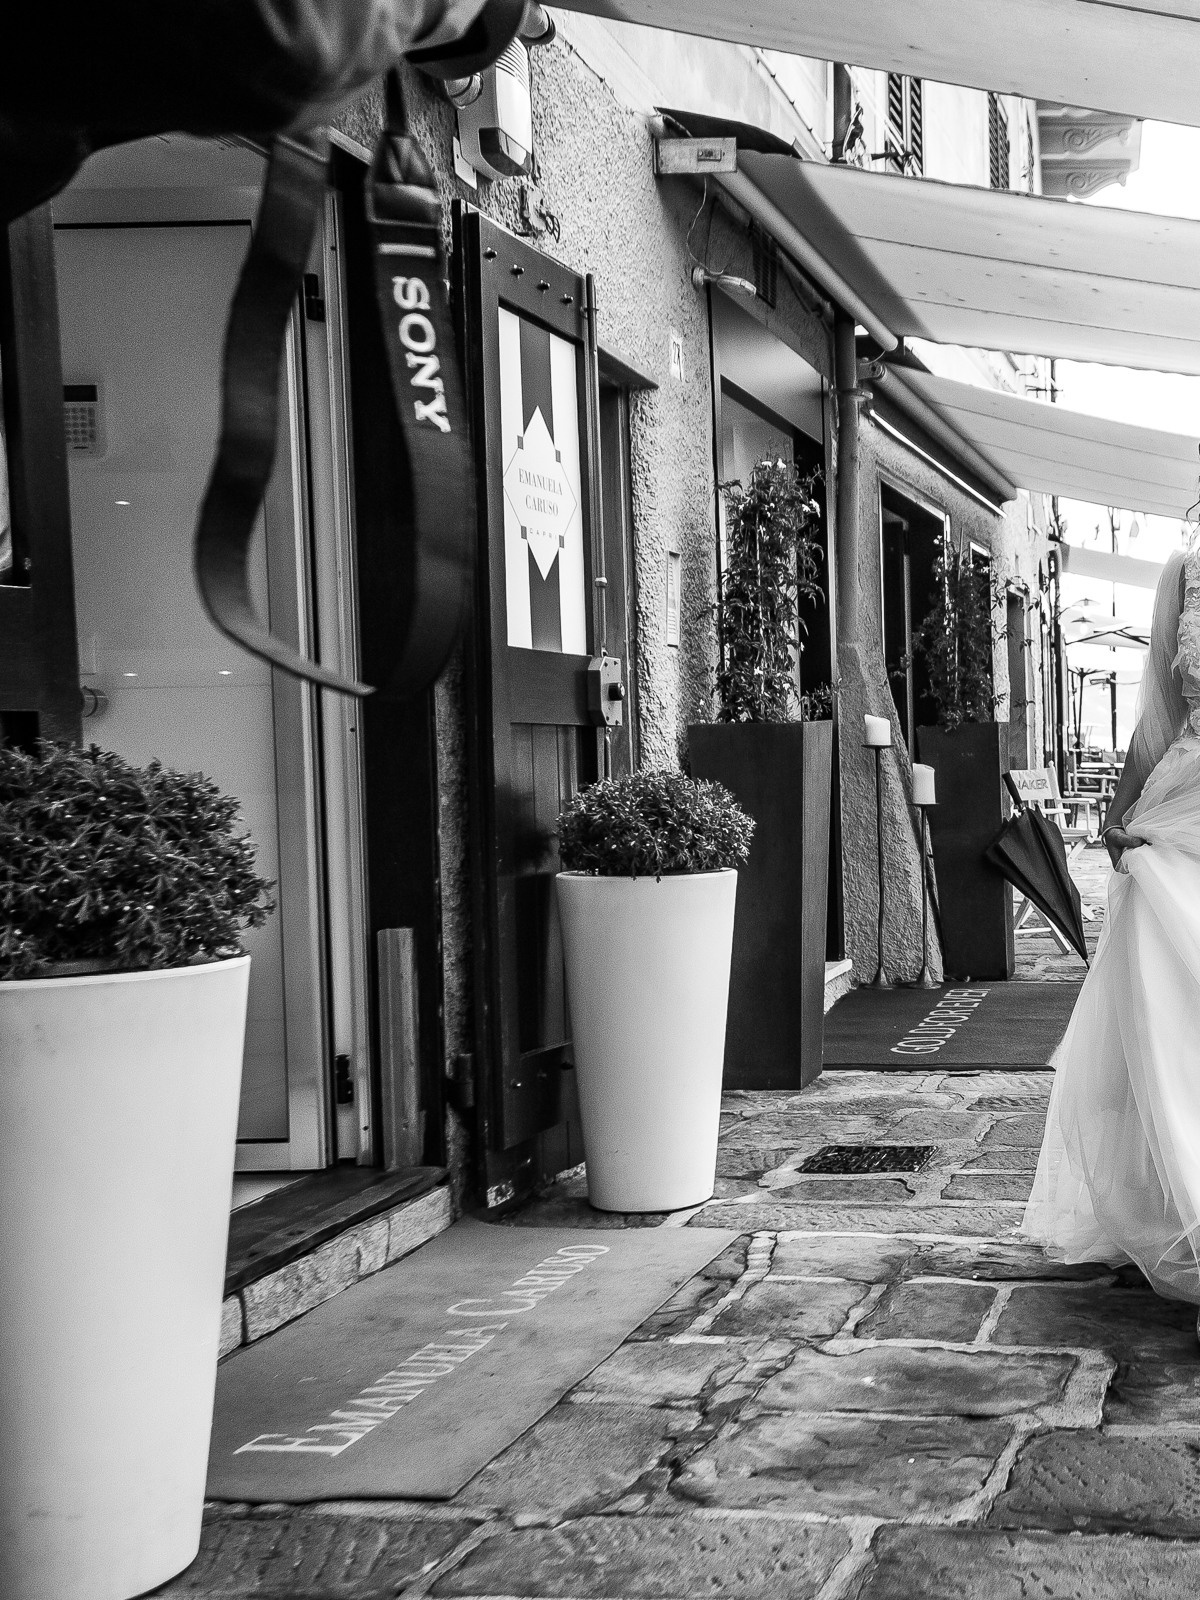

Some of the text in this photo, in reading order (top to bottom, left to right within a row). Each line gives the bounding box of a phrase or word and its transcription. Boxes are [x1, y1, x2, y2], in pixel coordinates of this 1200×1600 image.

[392, 275, 451, 433] SONY
[519, 468, 563, 496] EMANUELA
[525, 494, 559, 517] CARUSO
[890, 1027, 957, 1055] GOLD
[232, 1244, 611, 1457] EMANUELA CARUSO
